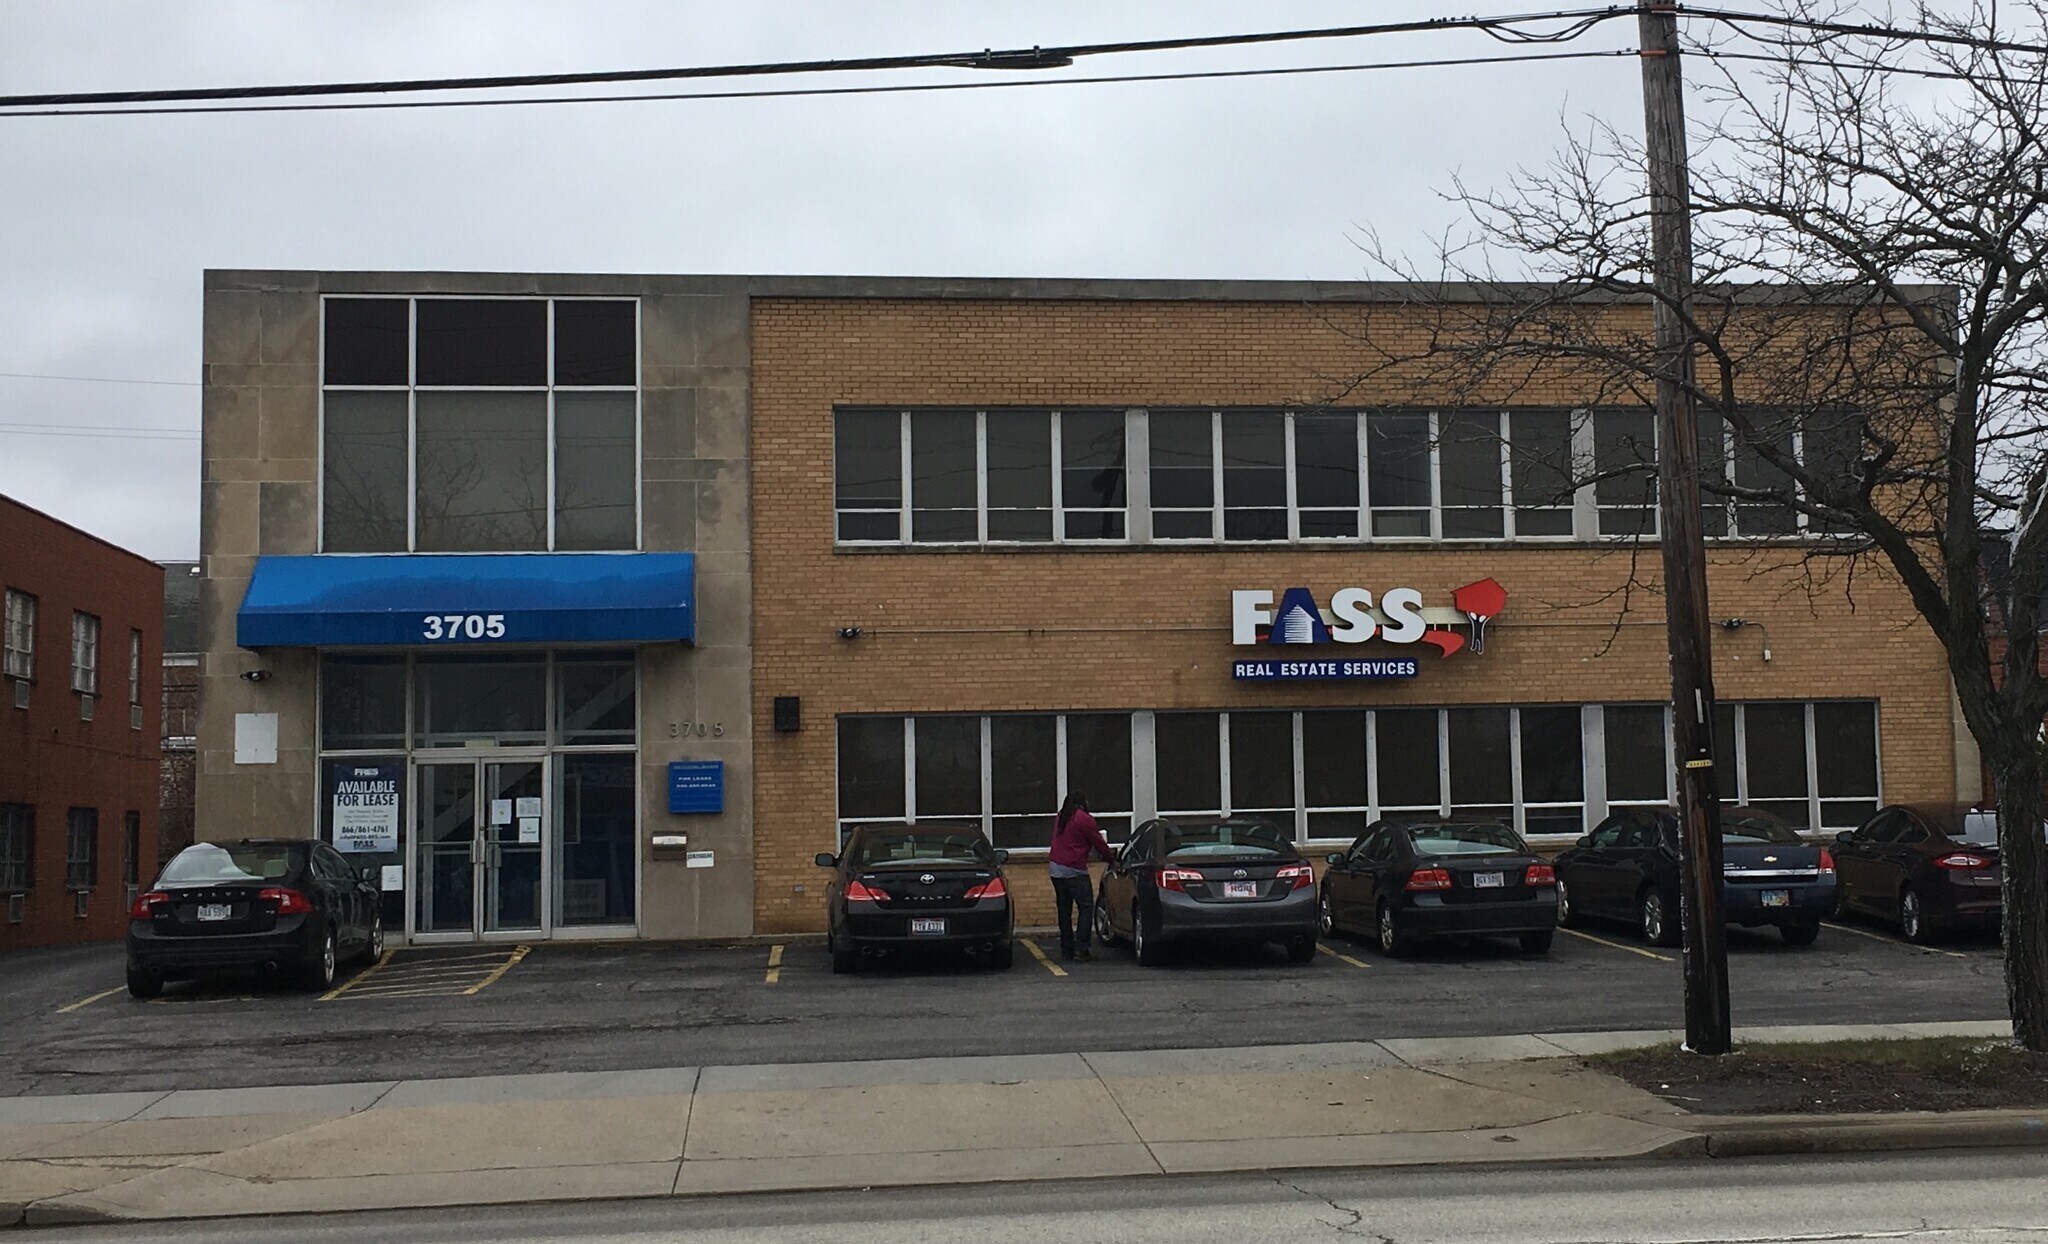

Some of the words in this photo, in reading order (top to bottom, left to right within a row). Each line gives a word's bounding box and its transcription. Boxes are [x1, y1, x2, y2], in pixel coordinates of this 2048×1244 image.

[1232, 586, 1427, 645] FASS
[423, 614, 506, 640] 3705
[1236, 662, 1274, 677] REAL
[1281, 662, 1337, 676] ESTATE
[1343, 661, 1416, 676] SERVICES
[669, 721, 725, 738] 3705
[337, 780, 396, 794] AVAILABLE
[337, 795, 359, 807] FOR
[363, 794, 395, 806] LEASE
